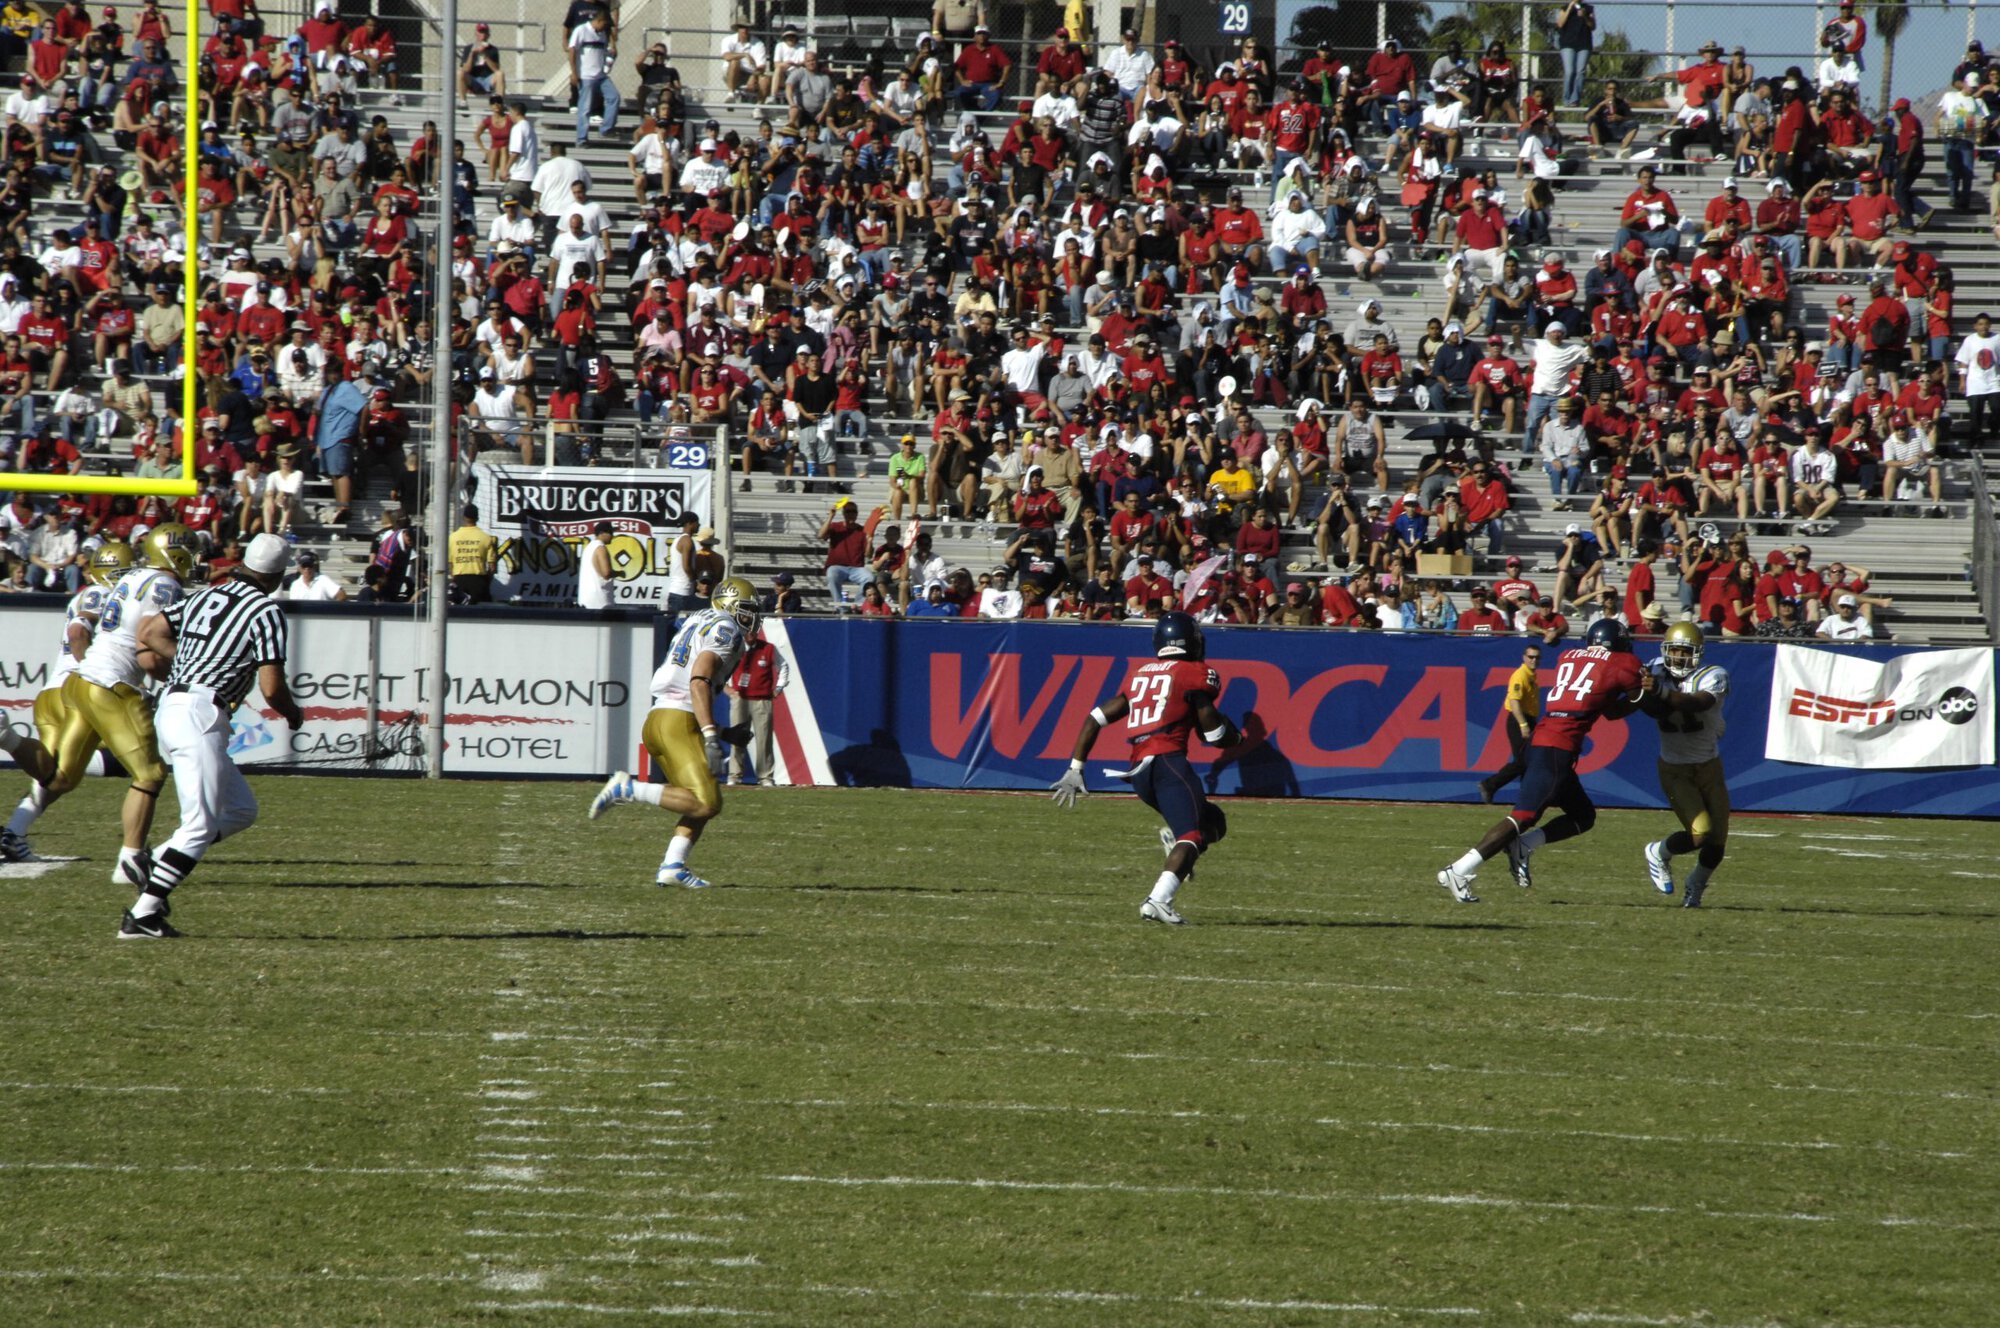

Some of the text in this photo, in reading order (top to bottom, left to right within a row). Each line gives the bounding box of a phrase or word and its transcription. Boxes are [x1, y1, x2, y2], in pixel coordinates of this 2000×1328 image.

[1223, 4, 1249, 31] 29
[1282, 114, 1303, 133] 32
[588, 358, 599, 375] 5
[671, 446, 706, 466] 29
[500, 485, 682, 520] BRUEGGER'S
[541, 524, 589, 536] BAKED
[613, 586, 663, 599] ONE
[187, 592, 230, 636] R
[1547, 662, 1596, 702] 84
[1127, 674, 1171, 728] 23
[1788, 687, 1977, 725] ESPN ON abc
[289, 732, 569, 760] CASINO HOTEL
